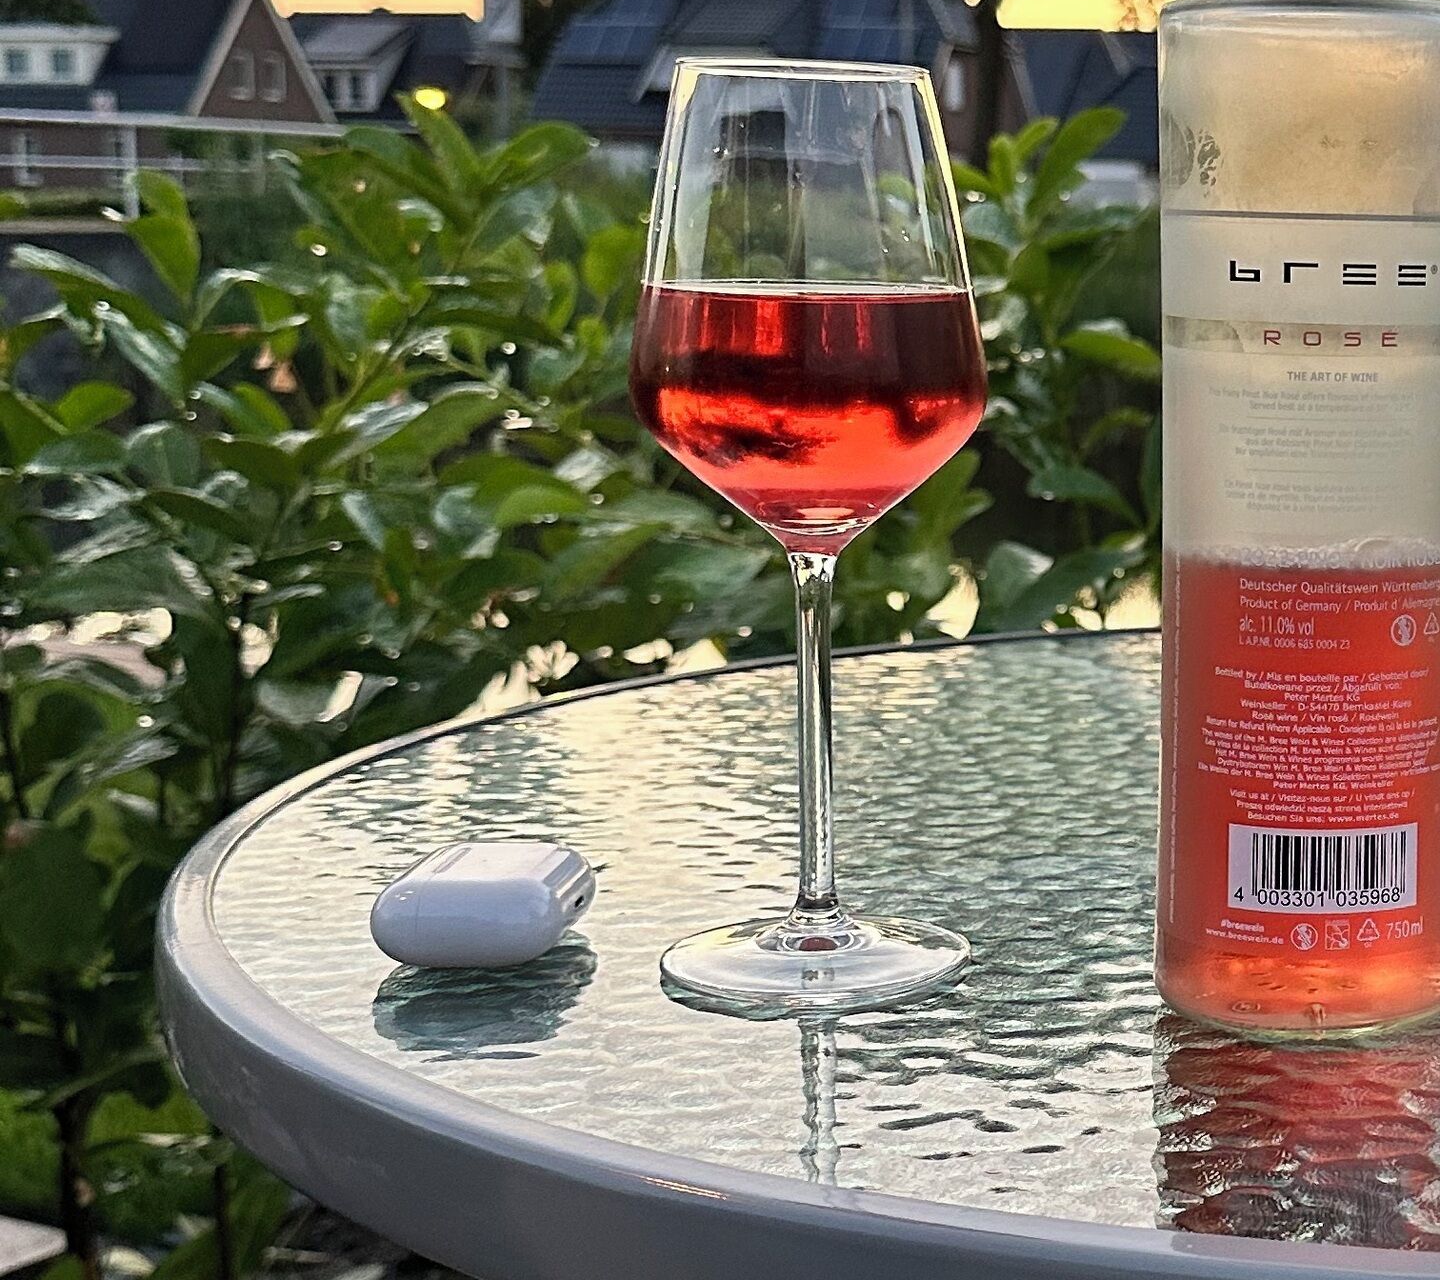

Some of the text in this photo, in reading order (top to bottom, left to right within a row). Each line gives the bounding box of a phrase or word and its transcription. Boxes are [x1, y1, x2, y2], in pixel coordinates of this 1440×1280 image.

[1287, 371, 1379, 383] THE ART OF WINE
[1239, 577, 1298, 592] Deutscher
[1300, 580, 1379, 596] Qualitätswein
[1239, 595, 1279, 610] Product
[1281, 599, 1293, 610] of
[1295, 600, 1342, 614] Germany
[1354, 600, 1389, 612] Produit
[1239, 613, 1315, 636] alc. 11.0% vol
[1246, 671, 1257, 682] by
[1267, 672, 1282, 682] Mis
[1285, 674, 1297, 682] en
[1300, 673, 1340, 683] bouteille
[1343, 675, 1360, 684] par
[1285, 692, 1361, 702] Peter Mertes KG
[1277, 713, 1298, 721] wine
[1309, 713, 1325, 722] Vin
[1292, 724, 1332, 734] Applicable
[1273, 780, 1298, 790] Peter
[1299, 781, 1330, 790] Mertes
[1249, 791, 1259, 800] us
[1260, 792, 1270, 801] at
[1332, 794, 1348, 803] sur
[1247, 810, 1287, 822] Besuchen
[1289, 813, 1304, 822] Sie
[1328, 811, 1399, 823] www.mertes.de
[1234, 886, 1400, 907] 4 003301 035968
[1205, 927, 1284, 945] www.breewein.de
